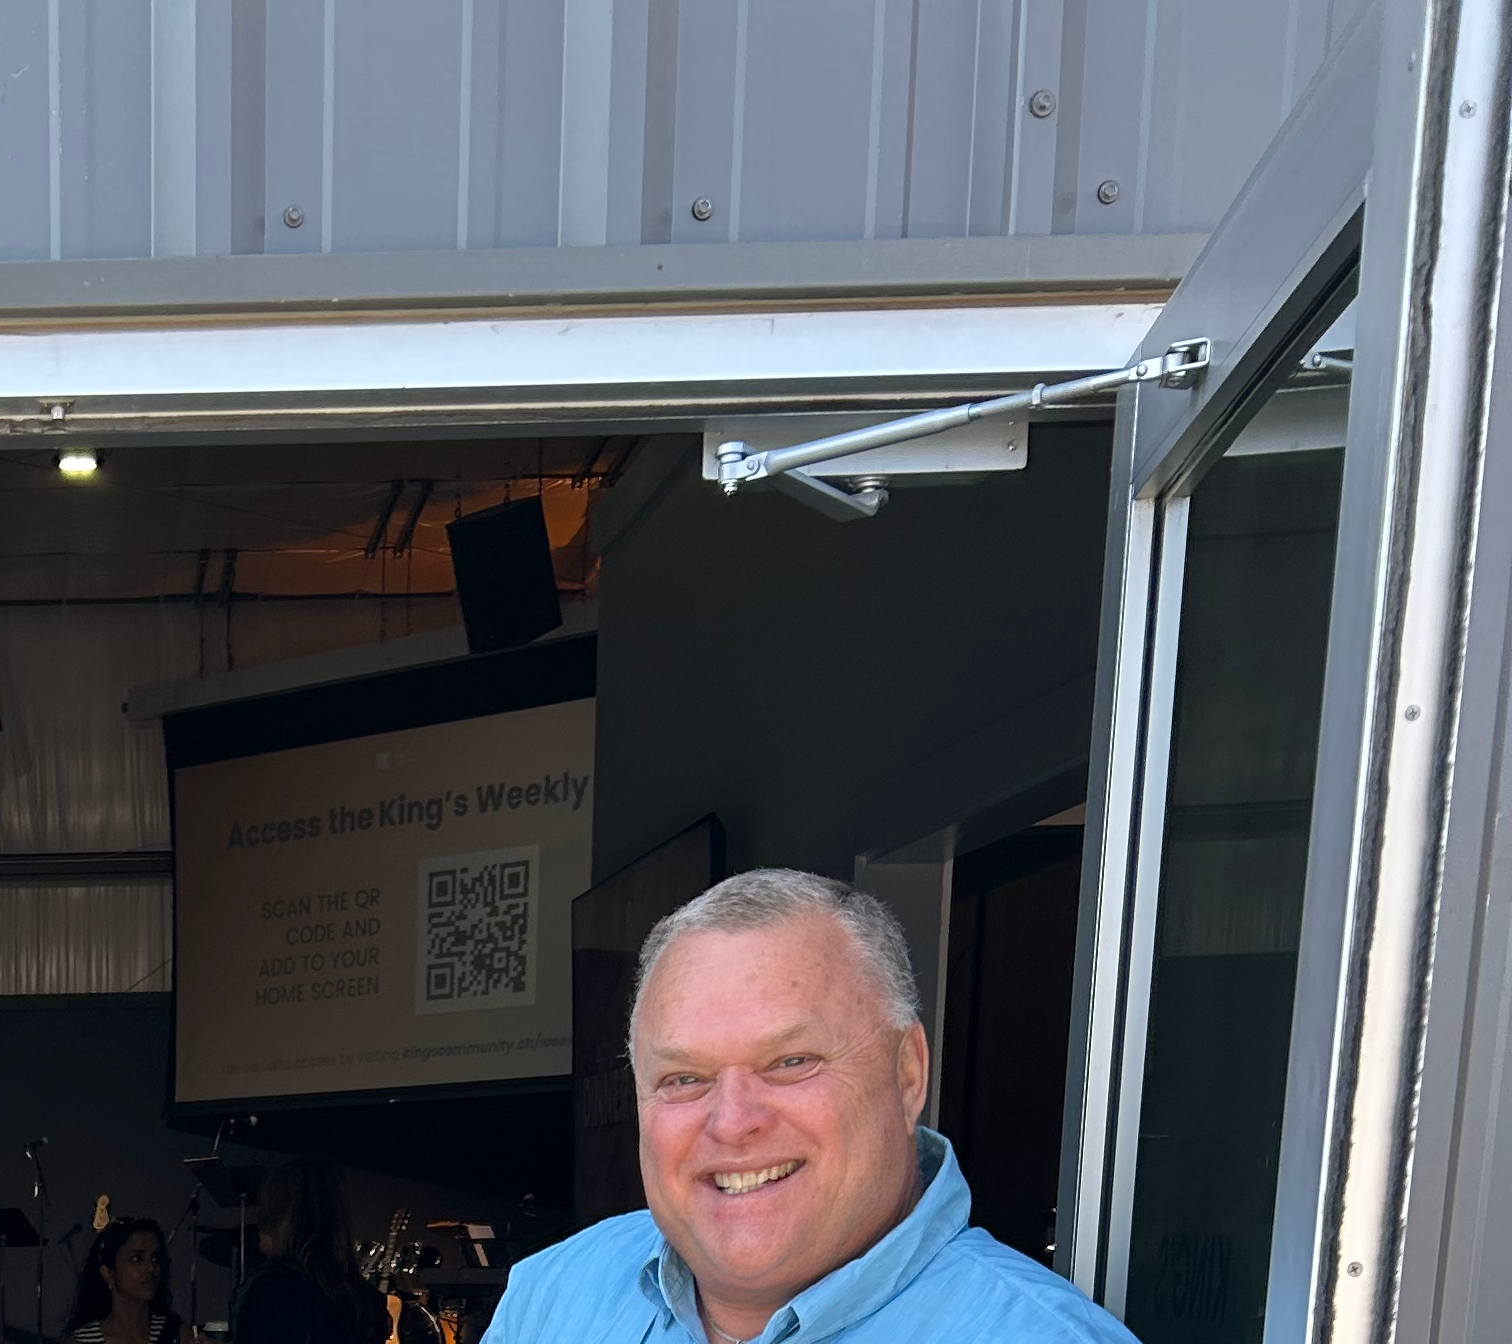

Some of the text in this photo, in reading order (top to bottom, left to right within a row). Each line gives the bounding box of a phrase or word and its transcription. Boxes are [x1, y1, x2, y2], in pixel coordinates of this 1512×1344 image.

[227, 770, 590, 851] Access the King's Weekly
[261, 887, 381, 920] SCAN THE QR
[285, 917, 381, 946] CODE AND
[258, 947, 379, 978] ADD TO YOUR
[255, 976, 379, 1006] HOME SCREEN
[295, 1055, 337, 1071] access
[340, 1052, 354, 1068] by
[402, 1031, 572, 1064] kingscommunity.ch/wee
